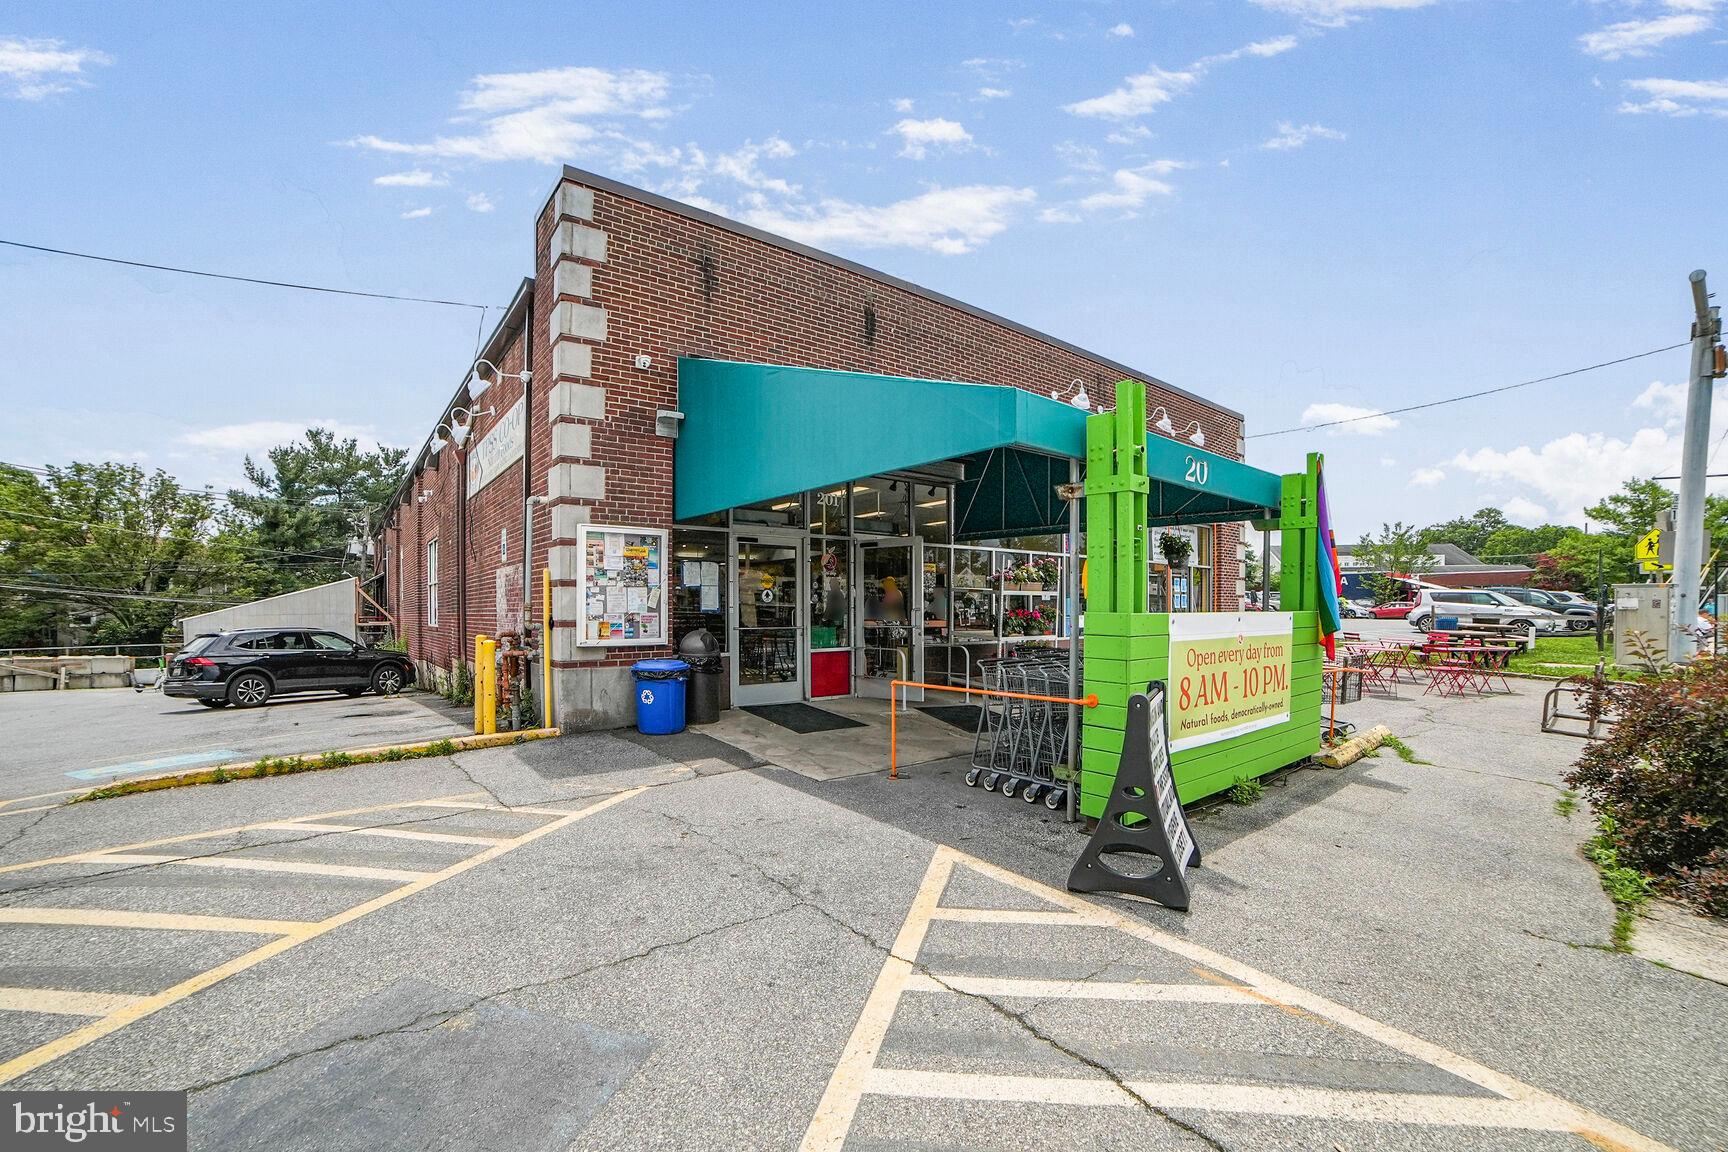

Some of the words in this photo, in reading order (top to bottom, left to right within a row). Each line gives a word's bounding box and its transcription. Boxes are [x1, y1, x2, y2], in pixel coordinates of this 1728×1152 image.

[498, 401, 524, 443] CO-OP
[1184, 455, 1208, 485] 20
[816, 491, 840, 507] 201
[1187, 648, 1216, 671] Open
[1218, 647, 1244, 665] every
[1245, 643, 1262, 663] day
[1263, 642, 1284, 658] from
[1179, 676, 1191, 711] 8
[1194, 671, 1229, 708] AM
[1242, 667, 1259, 699] 10
[1262, 663, 1288, 695] PM.
[1180, 714, 1208, 731] Natural
[1210, 710, 1230, 724] foods,
[1231, 698, 1284, 721] democratically-owned
